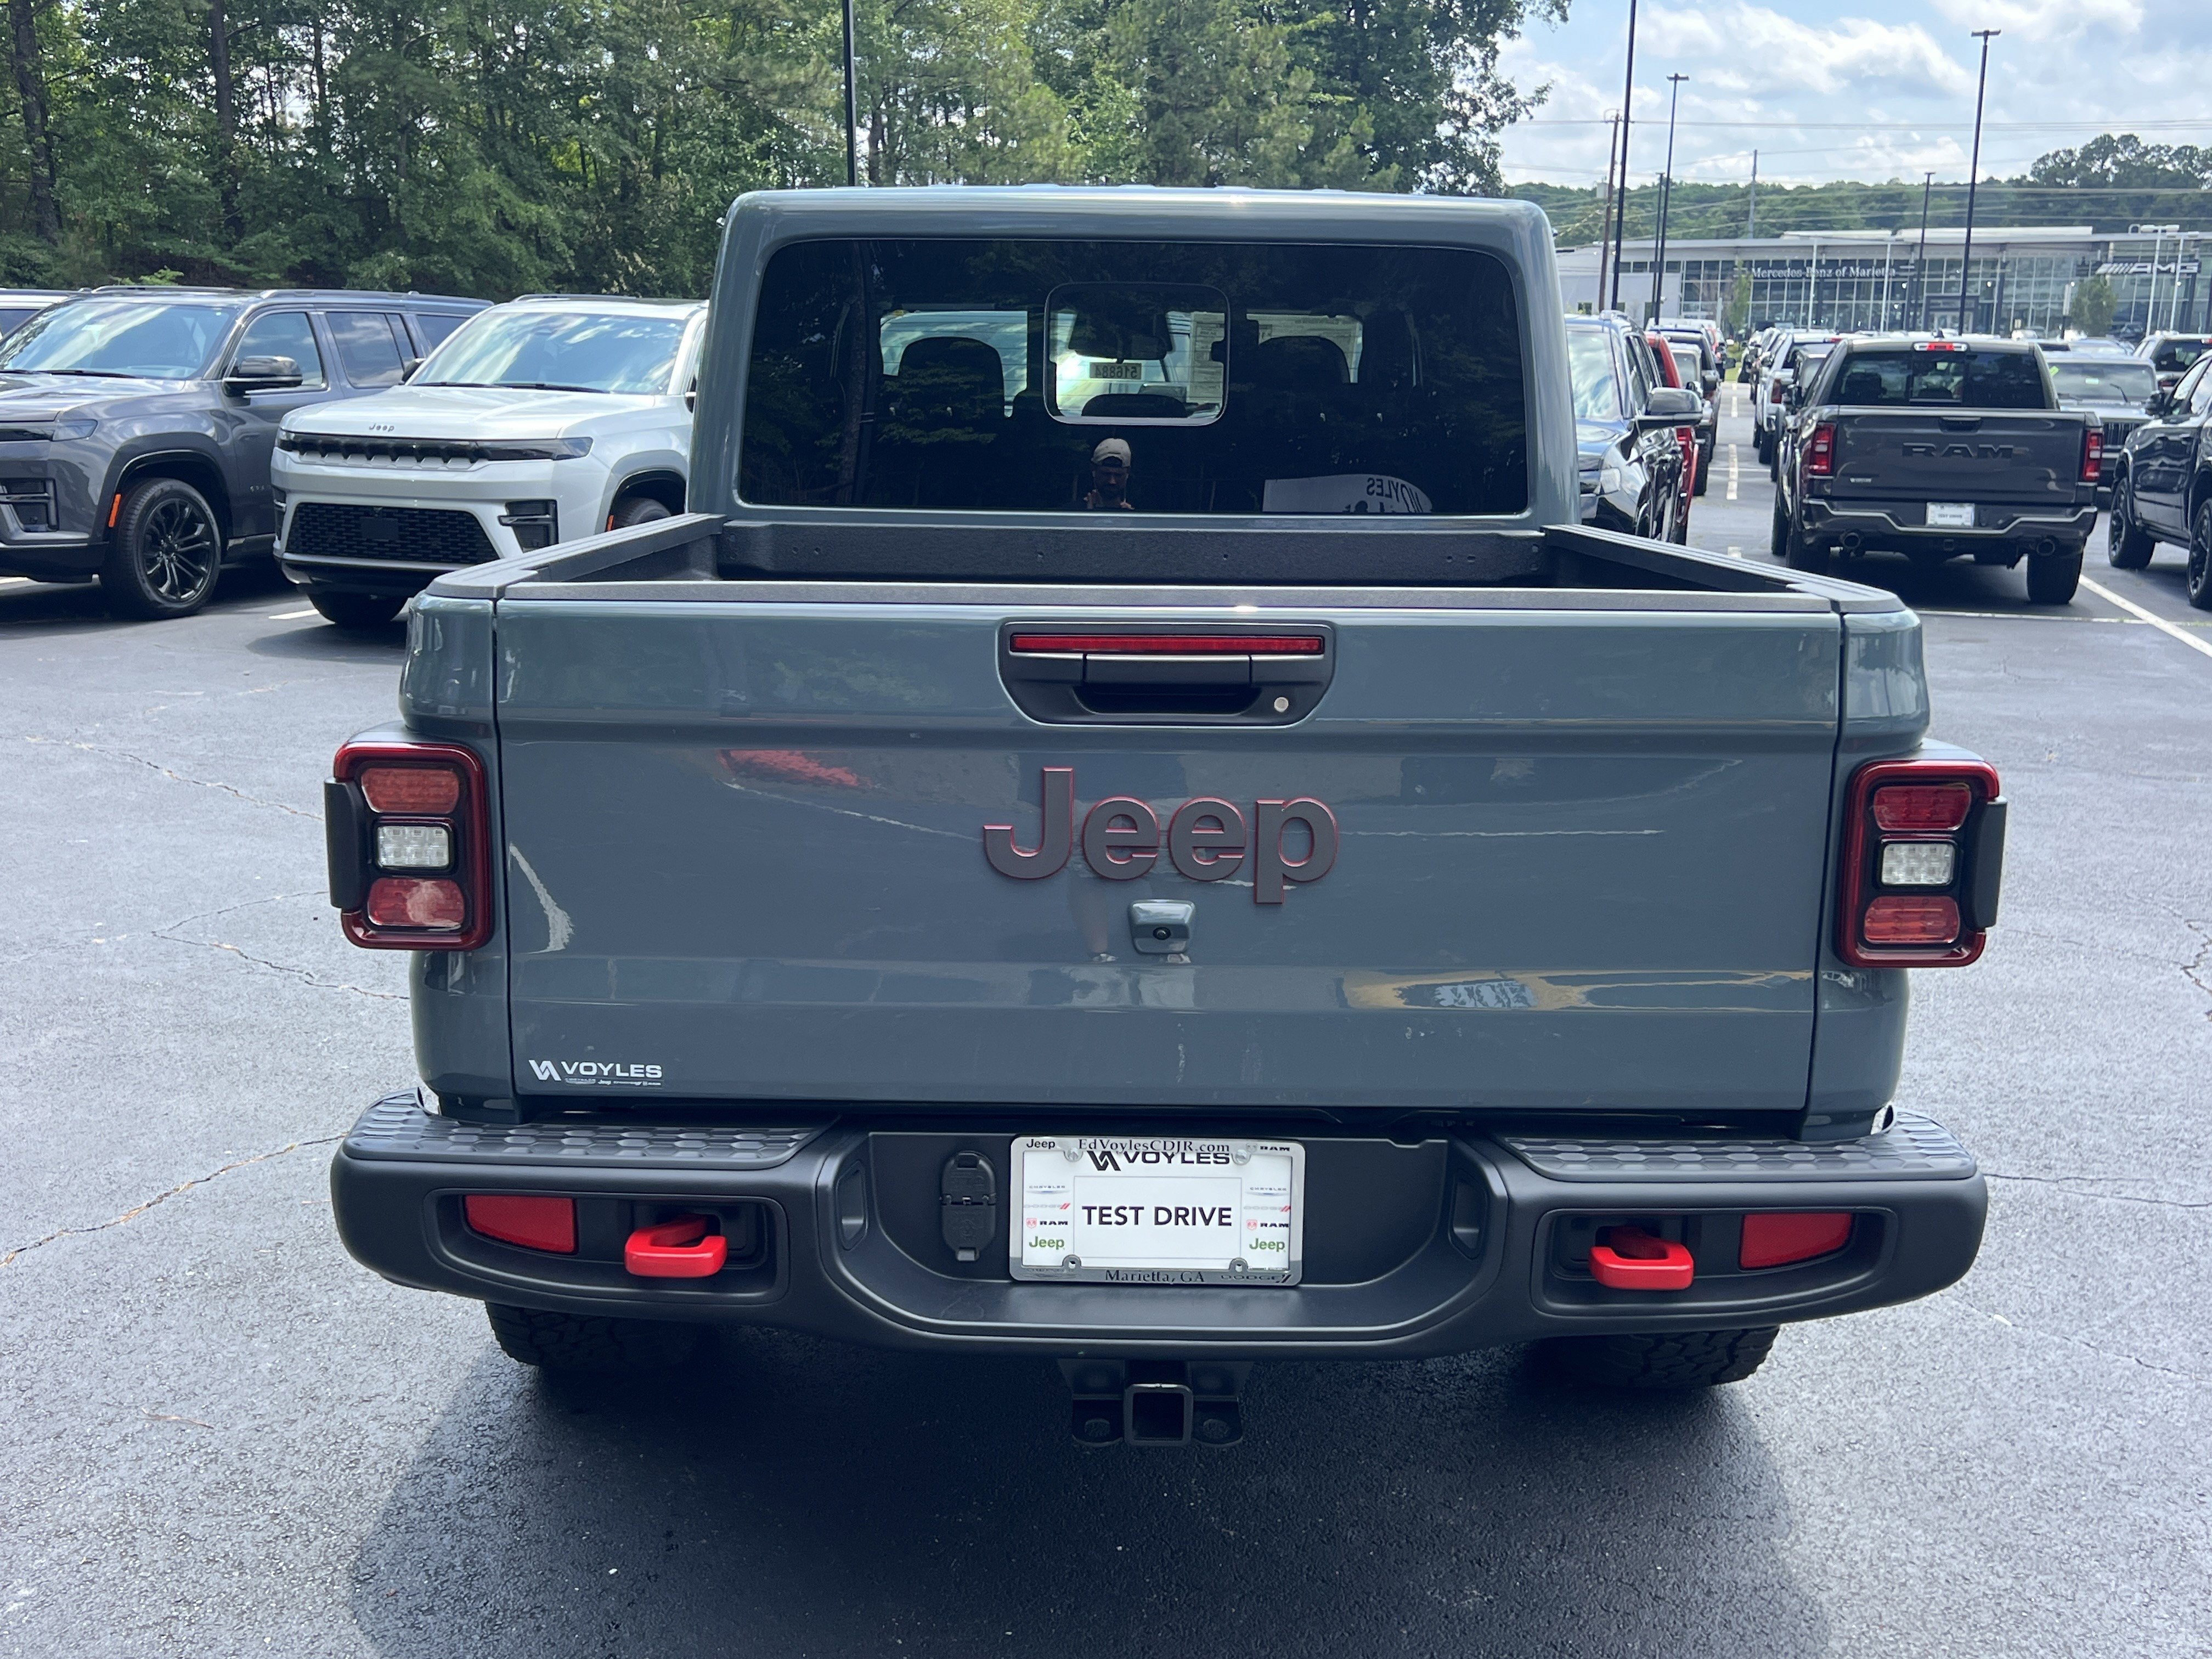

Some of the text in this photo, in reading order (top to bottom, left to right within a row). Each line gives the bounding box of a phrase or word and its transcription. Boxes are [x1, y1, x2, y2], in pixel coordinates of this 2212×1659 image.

[1835, 266, 1846, 278] of
[1849, 266, 1896, 278] Marieta
[2129, 262, 2200, 274] AMG
[1902, 442, 2014, 458] RAM
[984, 767, 1337, 904] Jeep
[561, 1061, 663, 1078] VOYLES
[1026, 1139, 1056, 1149] Jeep
[1079, 1139, 1230, 1154] EdVoylesCDJR.com
[1124, 1152, 1230, 1164] VOYLES
[1082, 1206, 1232, 1226] TEST DRIVE
[1029, 1236, 1065, 1250] Jeep
[1249, 1238, 1285, 1252] Jeep
[1105, 1270, 1204, 1283] Marietta, GA
